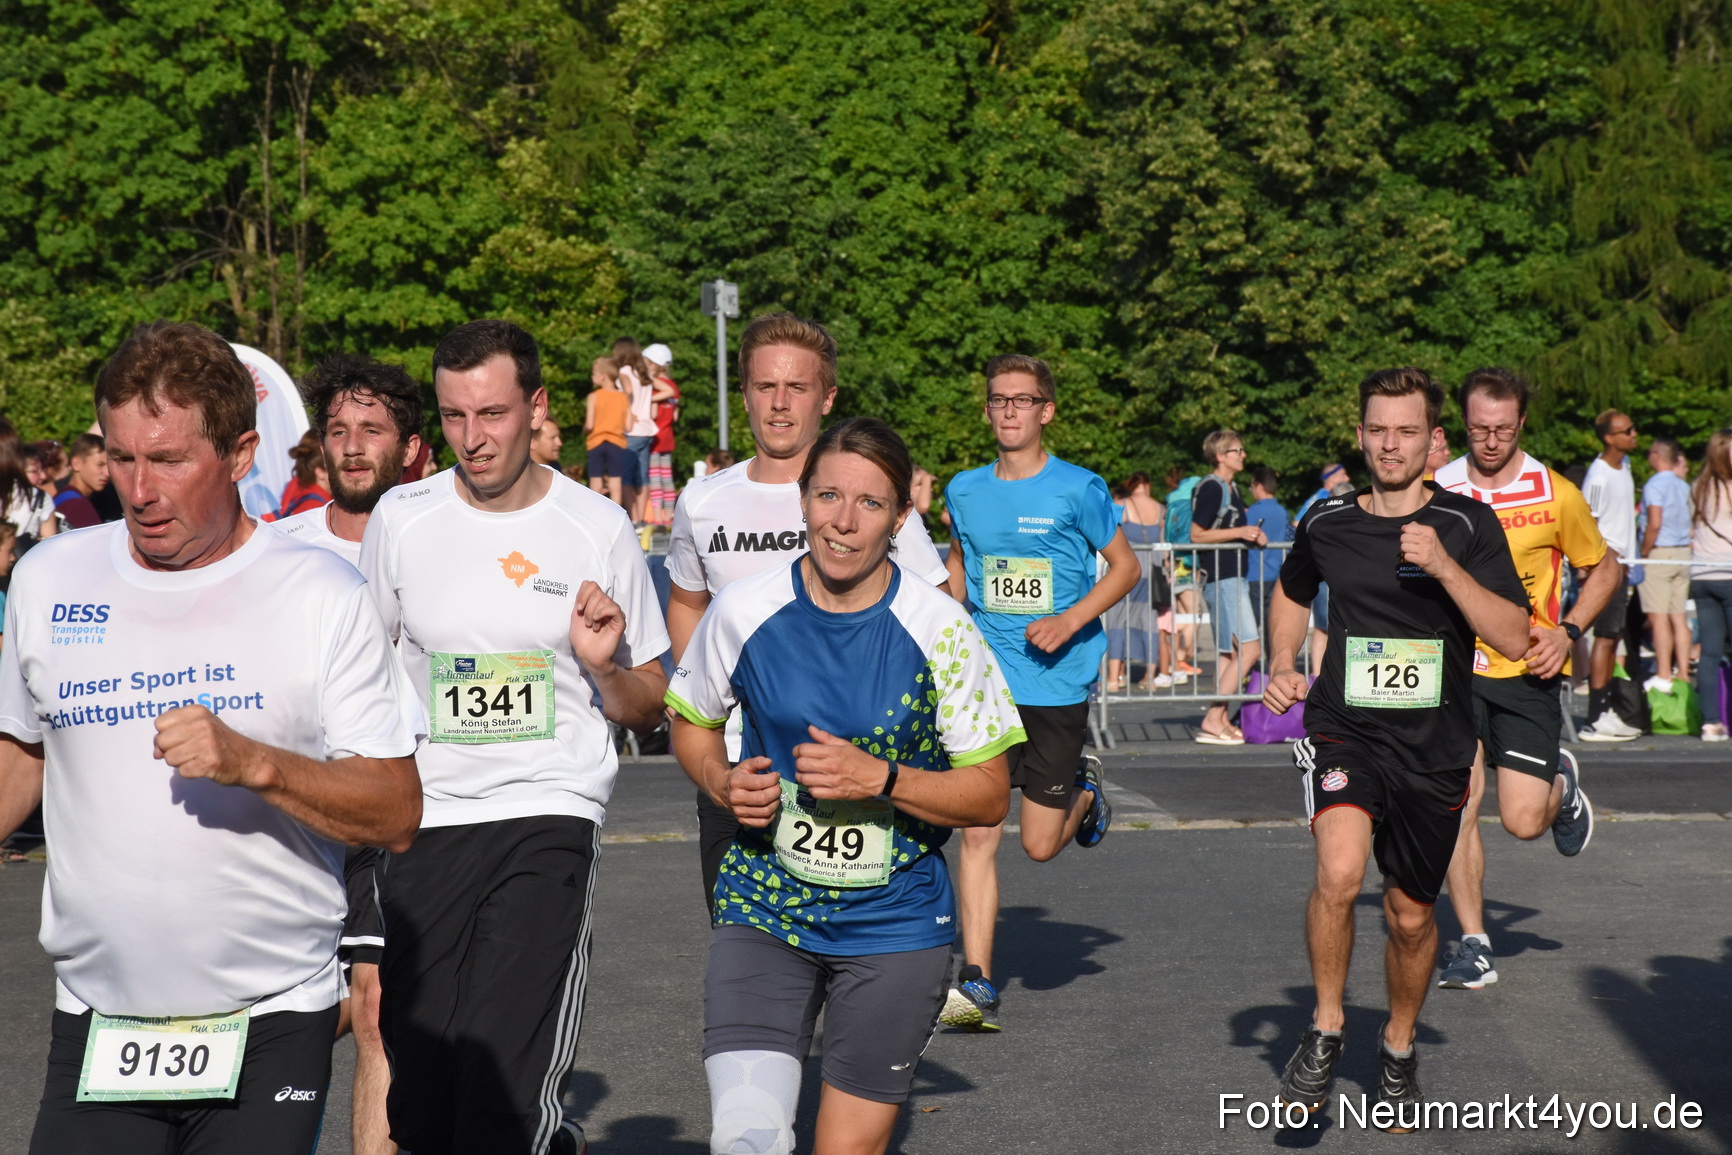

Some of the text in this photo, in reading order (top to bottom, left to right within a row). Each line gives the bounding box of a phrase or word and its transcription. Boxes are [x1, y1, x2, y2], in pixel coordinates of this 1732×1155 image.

[408, 488, 431, 498] JAKO
[1499, 510, 1556, 531] BÖGL
[510, 564, 525, 573] NM
[533, 578, 568, 590] LANDKREIS
[991, 577, 1042, 598] 1848
[532, 585, 568, 598] NEUMARKT
[51, 603, 110, 623] DESS
[51, 625, 106, 636] Transporte
[51, 636, 104, 645] Logistik
[447, 670, 494, 680] firmenlauf
[522, 674, 546, 682] 2019
[1367, 664, 1419, 688] 126
[58, 664, 235, 700] Unser Sport ist
[445, 684, 532, 718] 1341
[461, 718, 522, 728] König Stefan
[864, 816, 887, 826] 2019
[792, 820, 864, 861] 249
[814, 859, 838, 870] Anna
[841, 862, 884, 870] Katharina
[804, 866, 835, 877] Bionorica
[212, 1022, 240, 1033] 2019
[118, 1042, 210, 1077] 9130
[290, 1090, 318, 1101] asics
